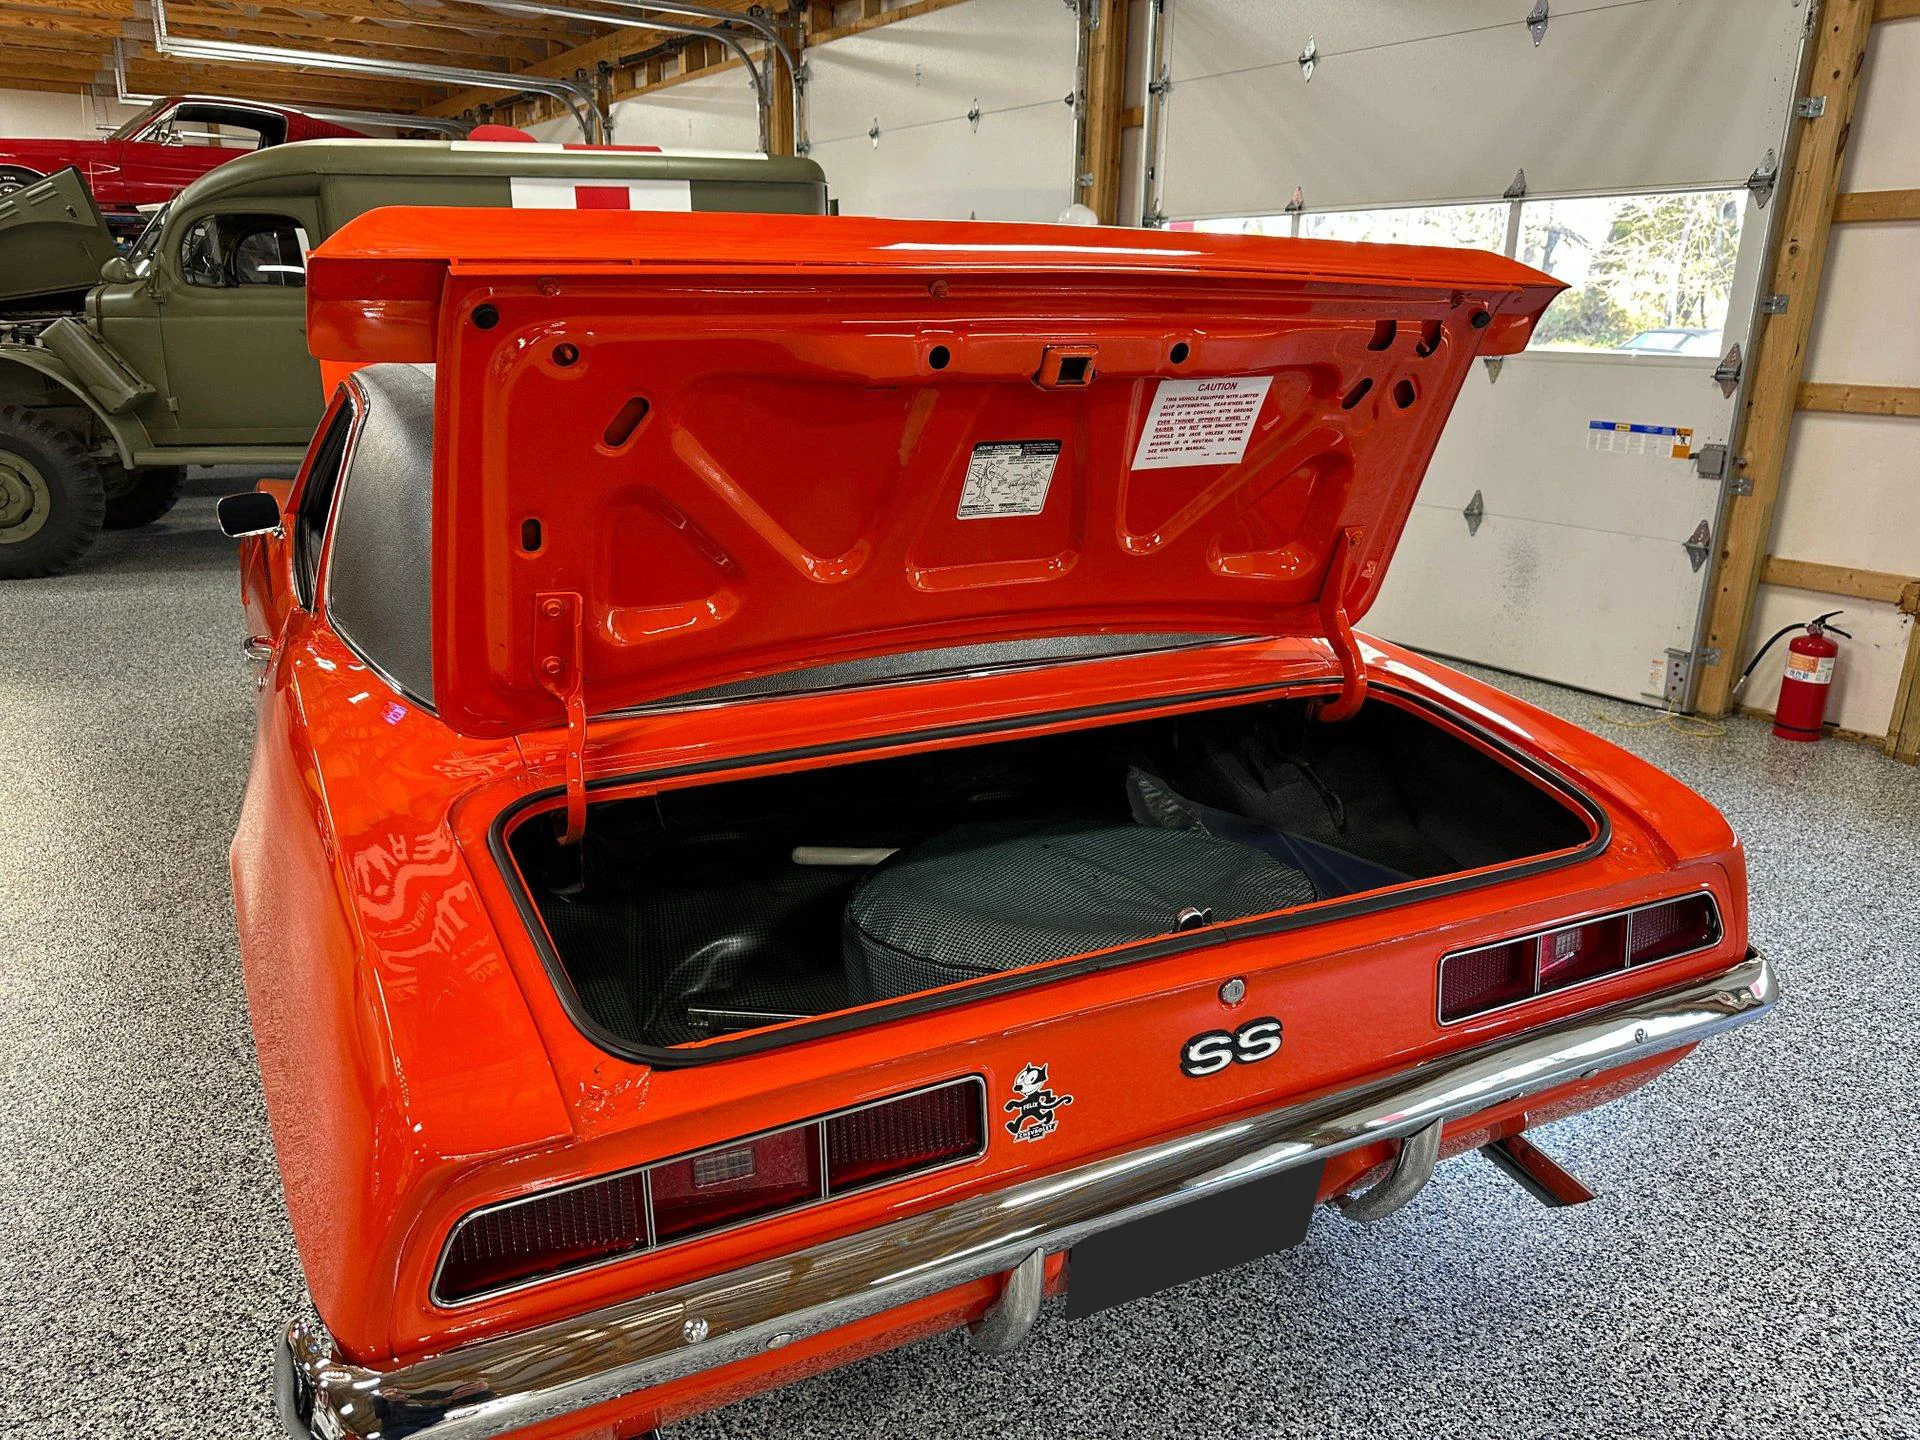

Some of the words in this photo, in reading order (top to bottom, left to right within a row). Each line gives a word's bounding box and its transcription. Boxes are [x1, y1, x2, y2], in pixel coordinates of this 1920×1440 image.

[1198, 382, 1238, 391] CAUTION
[1182, 1019, 1283, 1077] SS
[1023, 1101, 1039, 1110] FELIX
